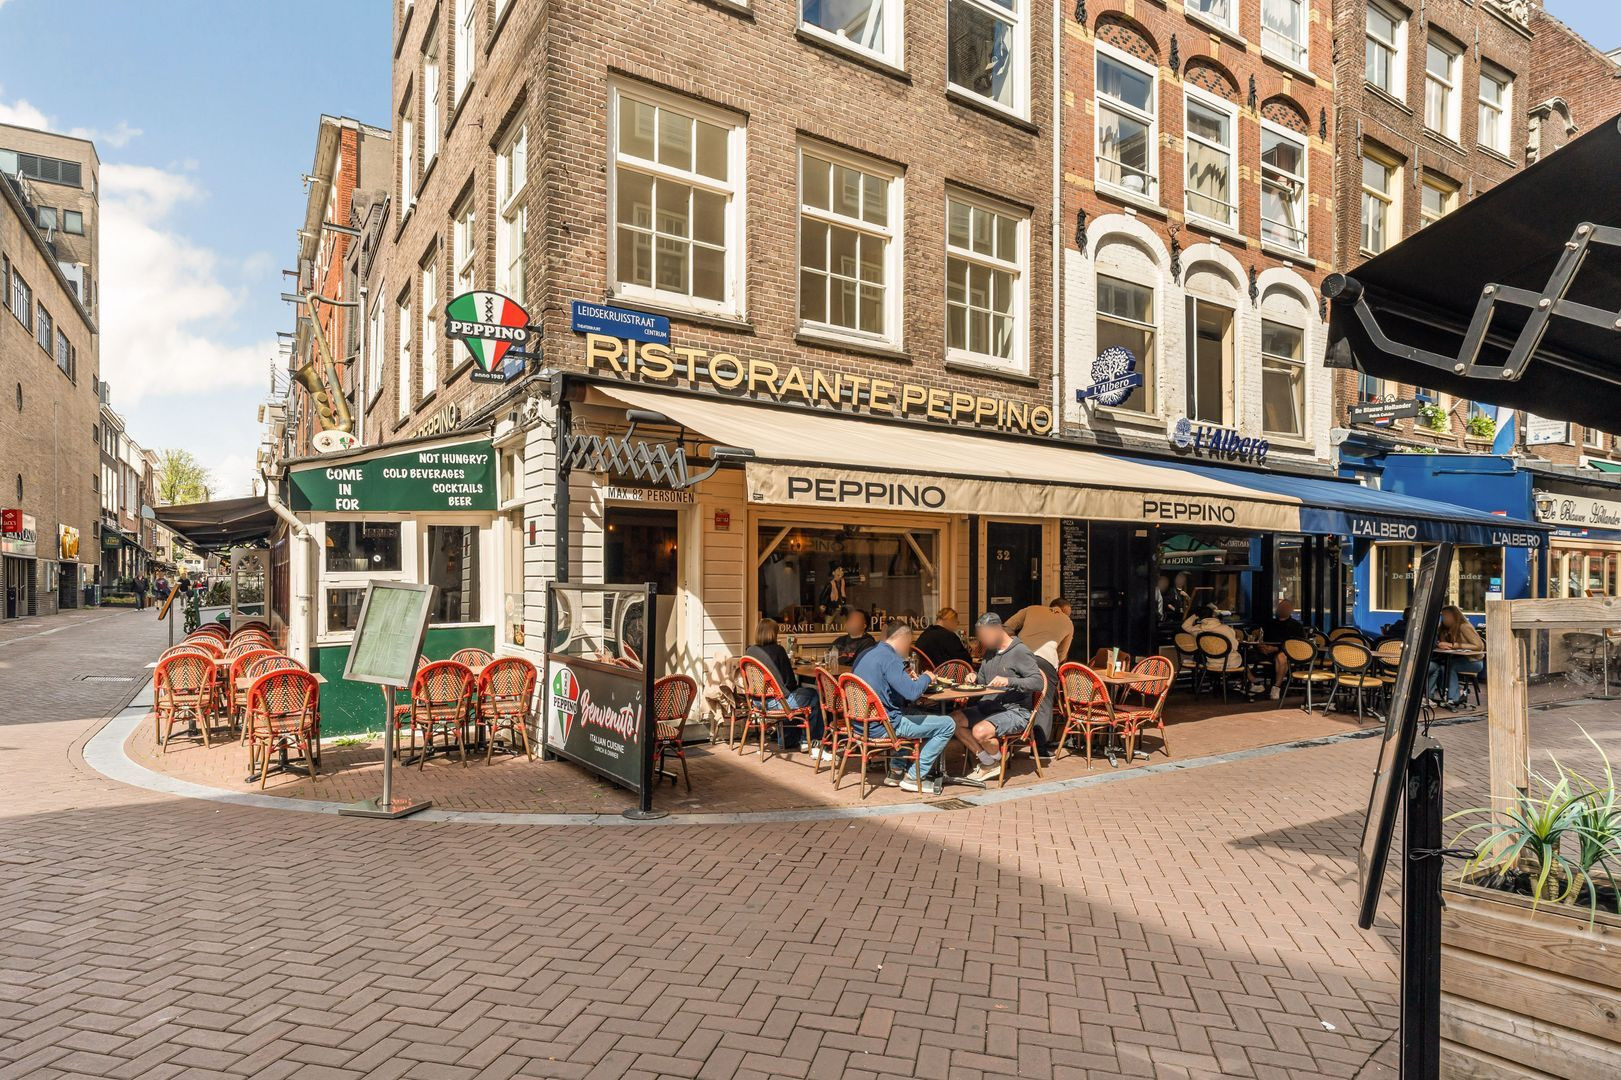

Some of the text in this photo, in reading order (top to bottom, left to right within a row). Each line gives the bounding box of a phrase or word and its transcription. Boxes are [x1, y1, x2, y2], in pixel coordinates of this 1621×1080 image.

[578, 305, 655, 328] LEIDSEKRUISSTRAAT
[450, 320, 526, 341] PEPPINO
[644, 328, 667, 338] CENTRUM
[586, 332, 1053, 434] RISTORANTE PEPPINO
[1093, 377, 1130, 396] L'Albero
[1194, 426, 1270, 458] L'Albero
[419, 453, 488, 465] NOT HUNGRY?
[326, 468, 363, 481] COME
[383, 468, 465, 479] COLD BEVERAGES
[338, 483, 352, 496] IN
[432, 483, 483, 494] COCKTAILS
[608, 487, 695, 503] MAX. 82 PERSONEN
[788, 476, 946, 508] PEPPINO
[335, 498, 359, 511] FOR
[448, 496, 472, 506] BEER
[1143, 500, 1236, 523] PEPPINO
[1352, 519, 1417, 539] L'ALBERO
[1492, 532, 1541, 547] L'ALBERO
[996, 549, 1011, 560] 32
[1392, 572, 1404, 580] De
[553, 696, 578, 715] PEPPINO
[580, 689, 642, 744] Benvenuto!
[589, 733, 625, 754] ITALIAN CUISINE
